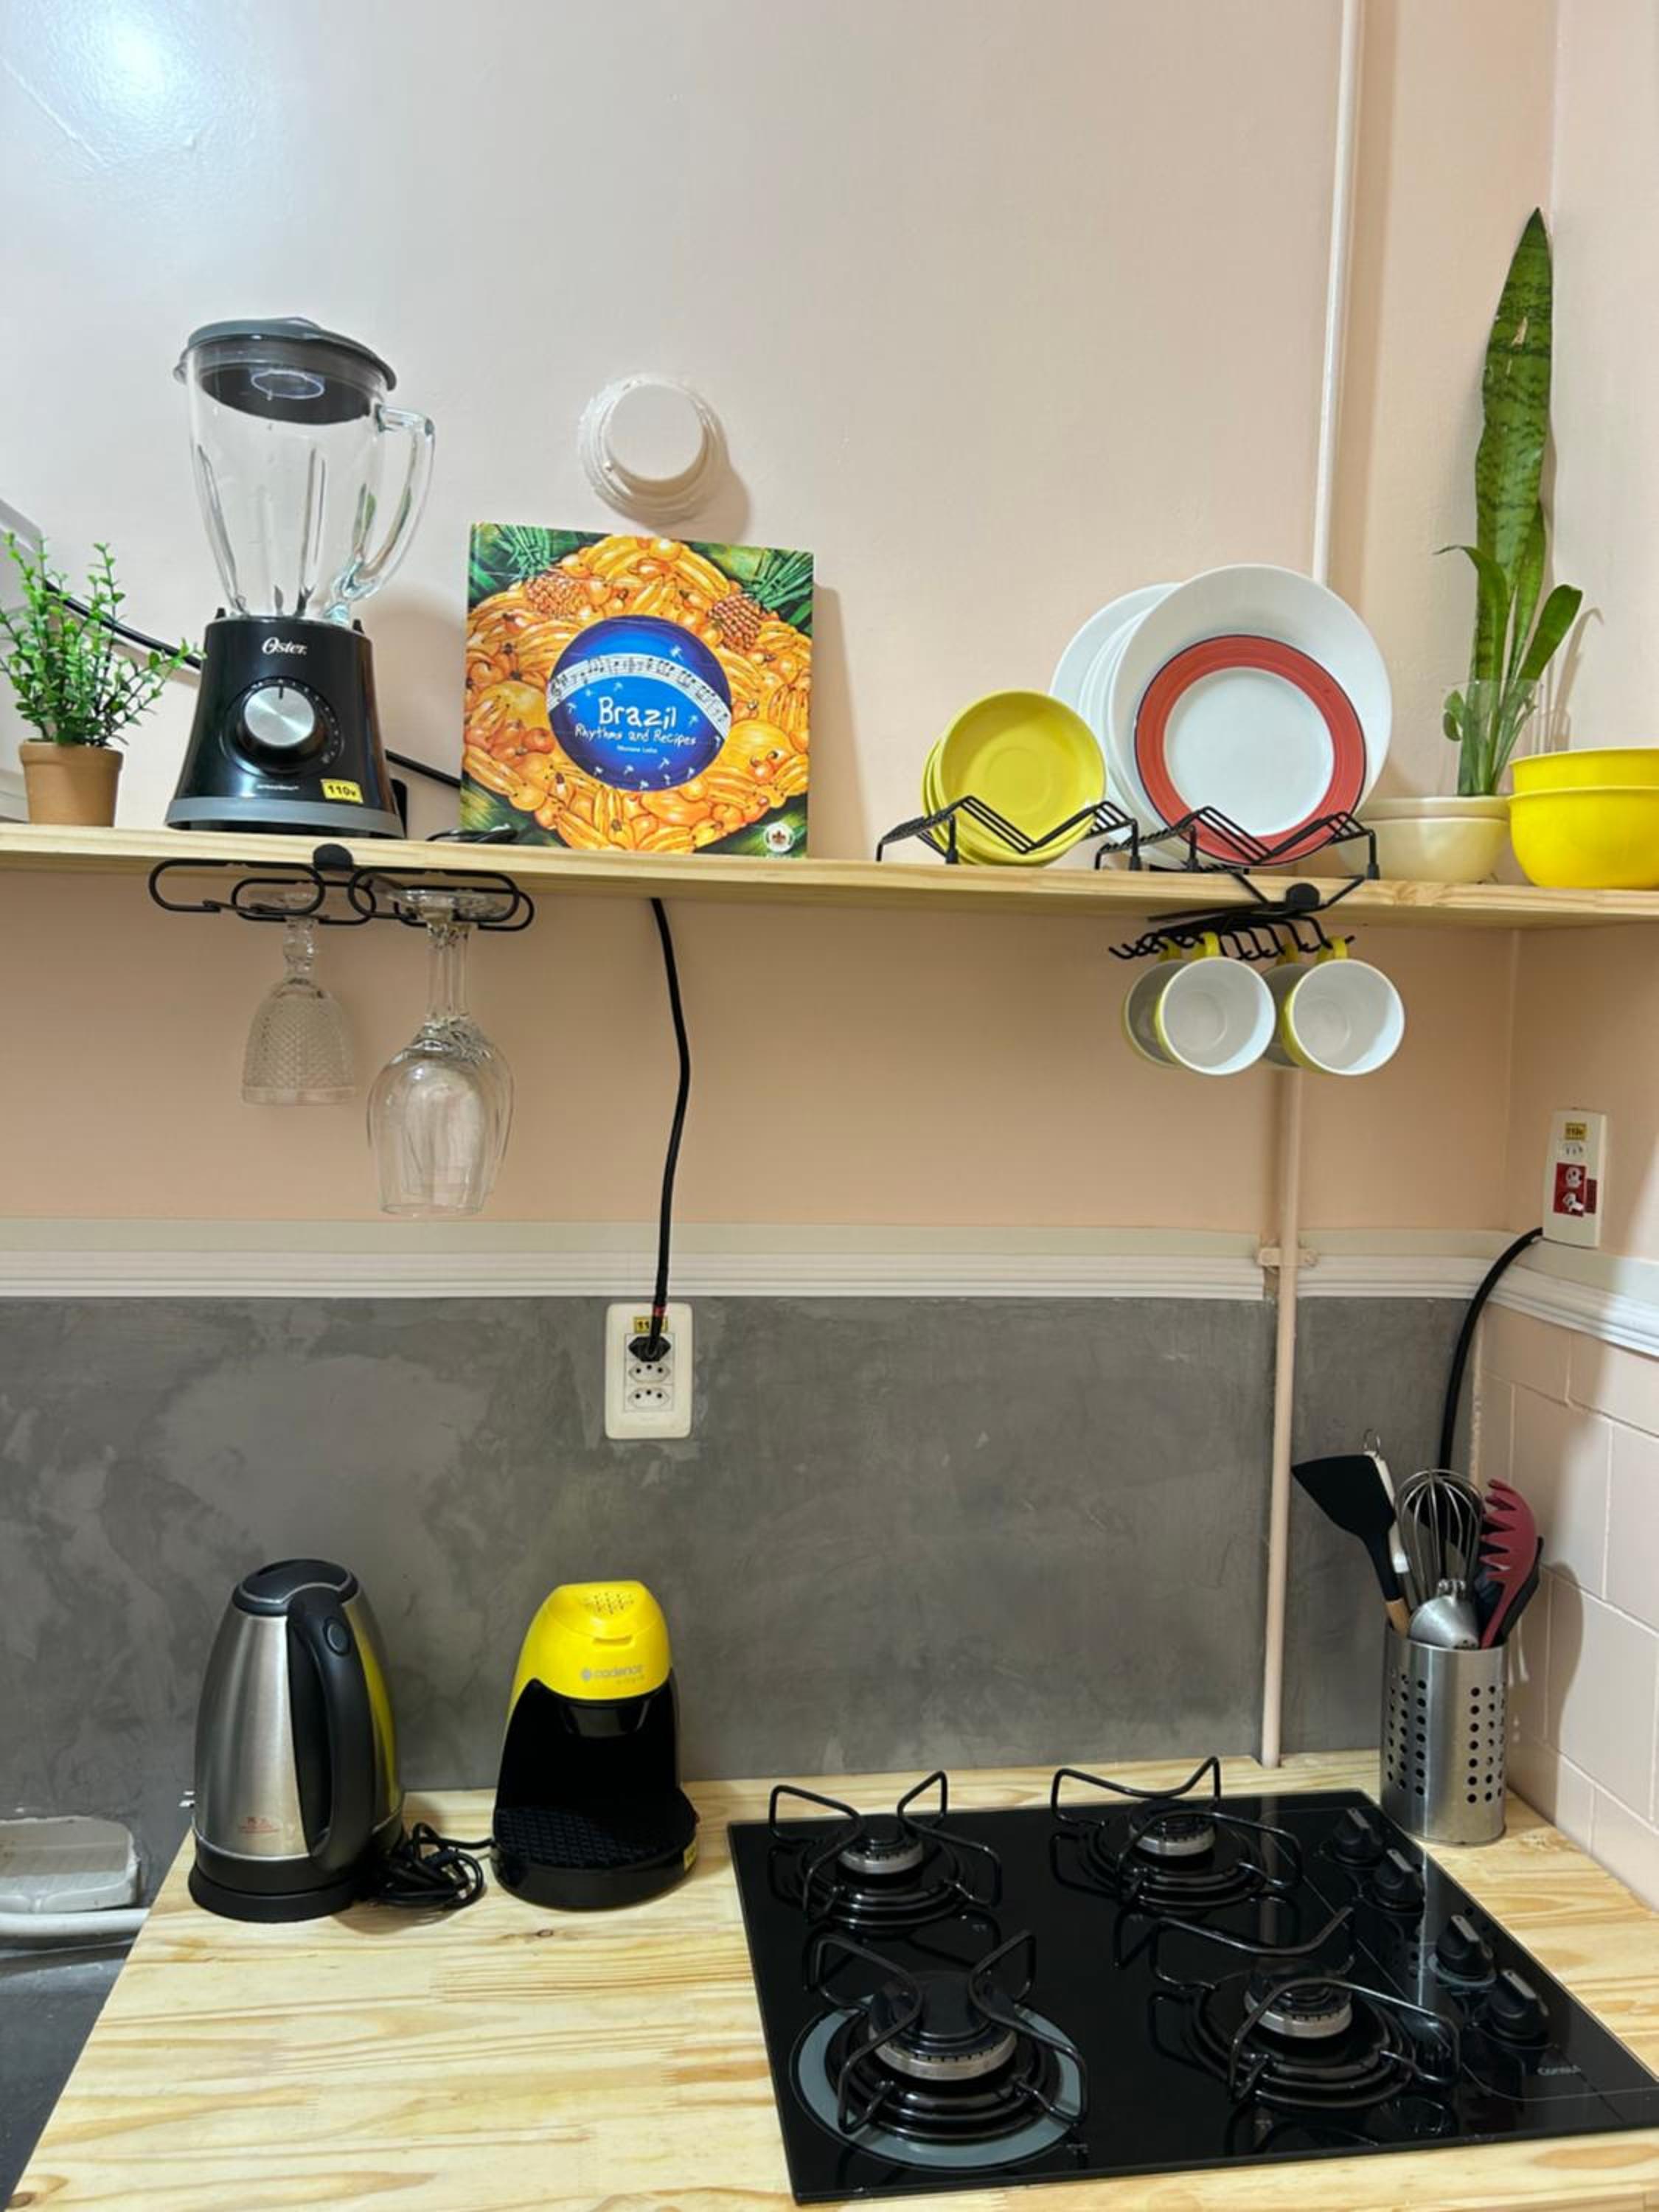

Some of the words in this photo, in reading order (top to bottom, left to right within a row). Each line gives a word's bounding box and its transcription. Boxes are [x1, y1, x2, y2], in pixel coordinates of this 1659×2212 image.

[598, 696, 678, 730] Brazil
[574, 723, 623, 742] Rhythms
[627, 728, 650, 742] and
[653, 729, 697, 748] Recipes
